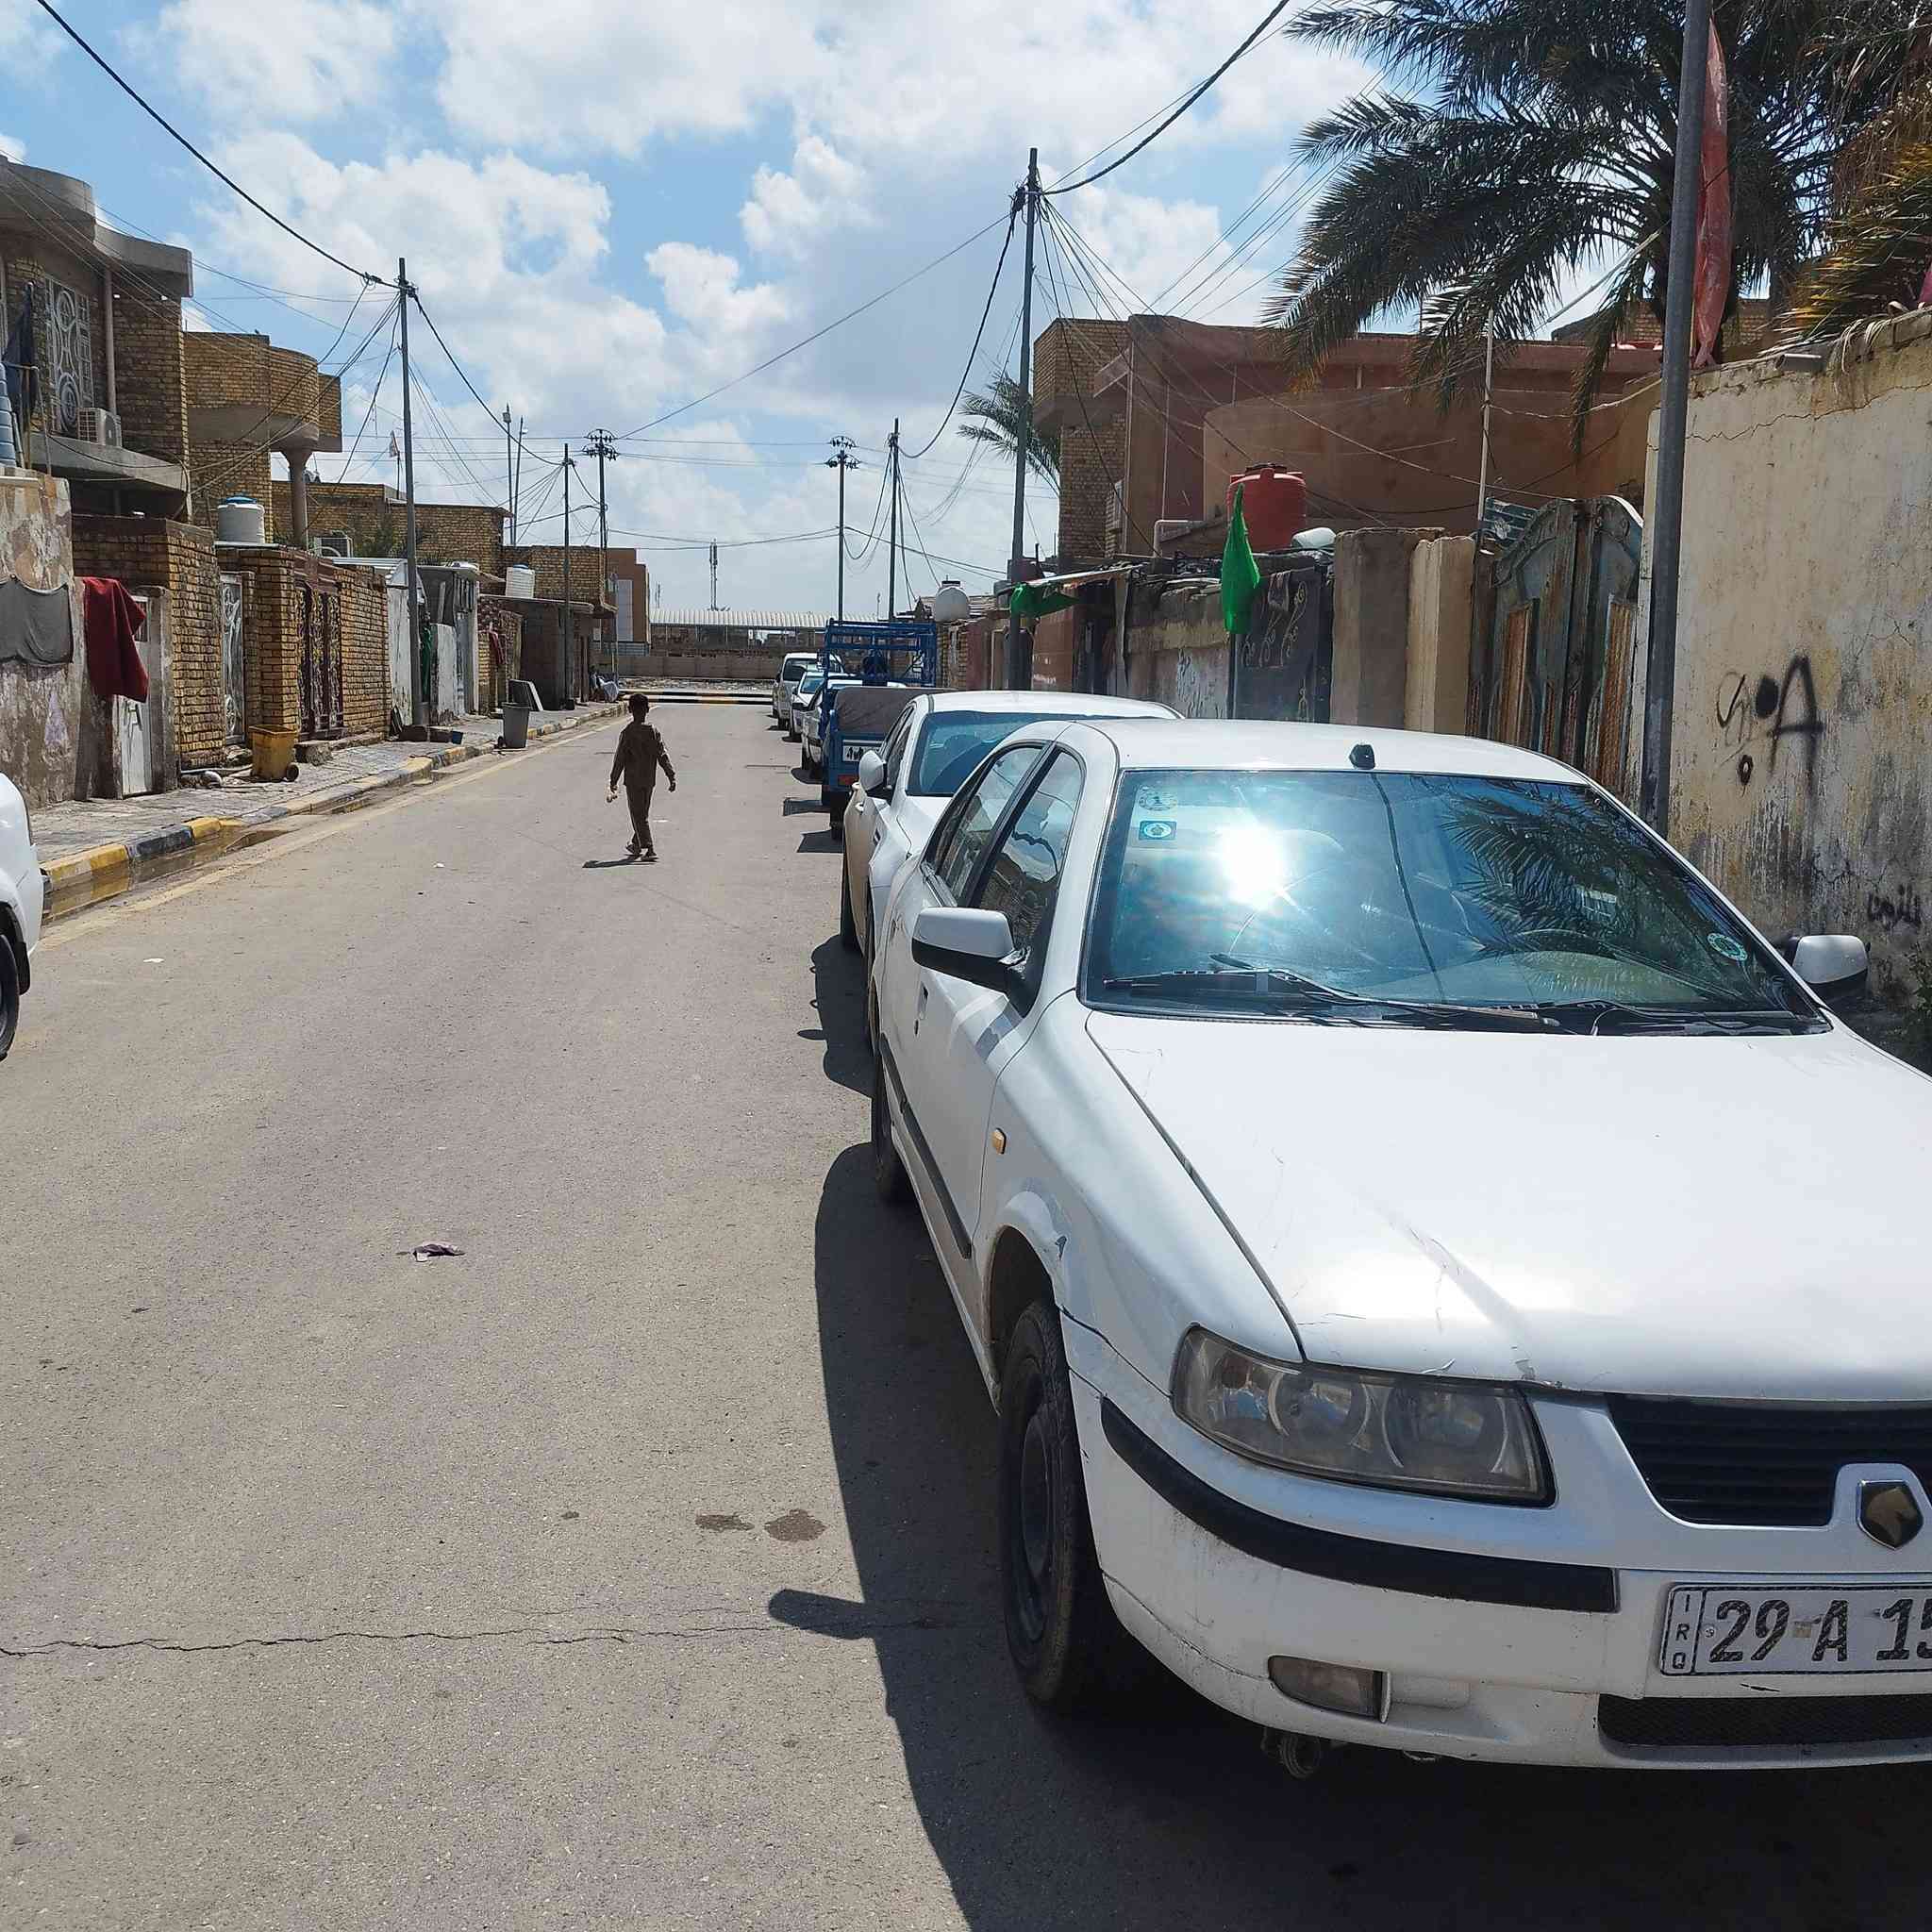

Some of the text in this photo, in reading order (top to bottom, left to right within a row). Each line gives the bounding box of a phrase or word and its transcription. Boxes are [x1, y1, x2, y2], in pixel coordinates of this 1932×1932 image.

[1672, 1593, 1691, 1670] IRQ
[1708, 1599, 1790, 1663] 29
[1811, 1599, 1849, 1662] A
